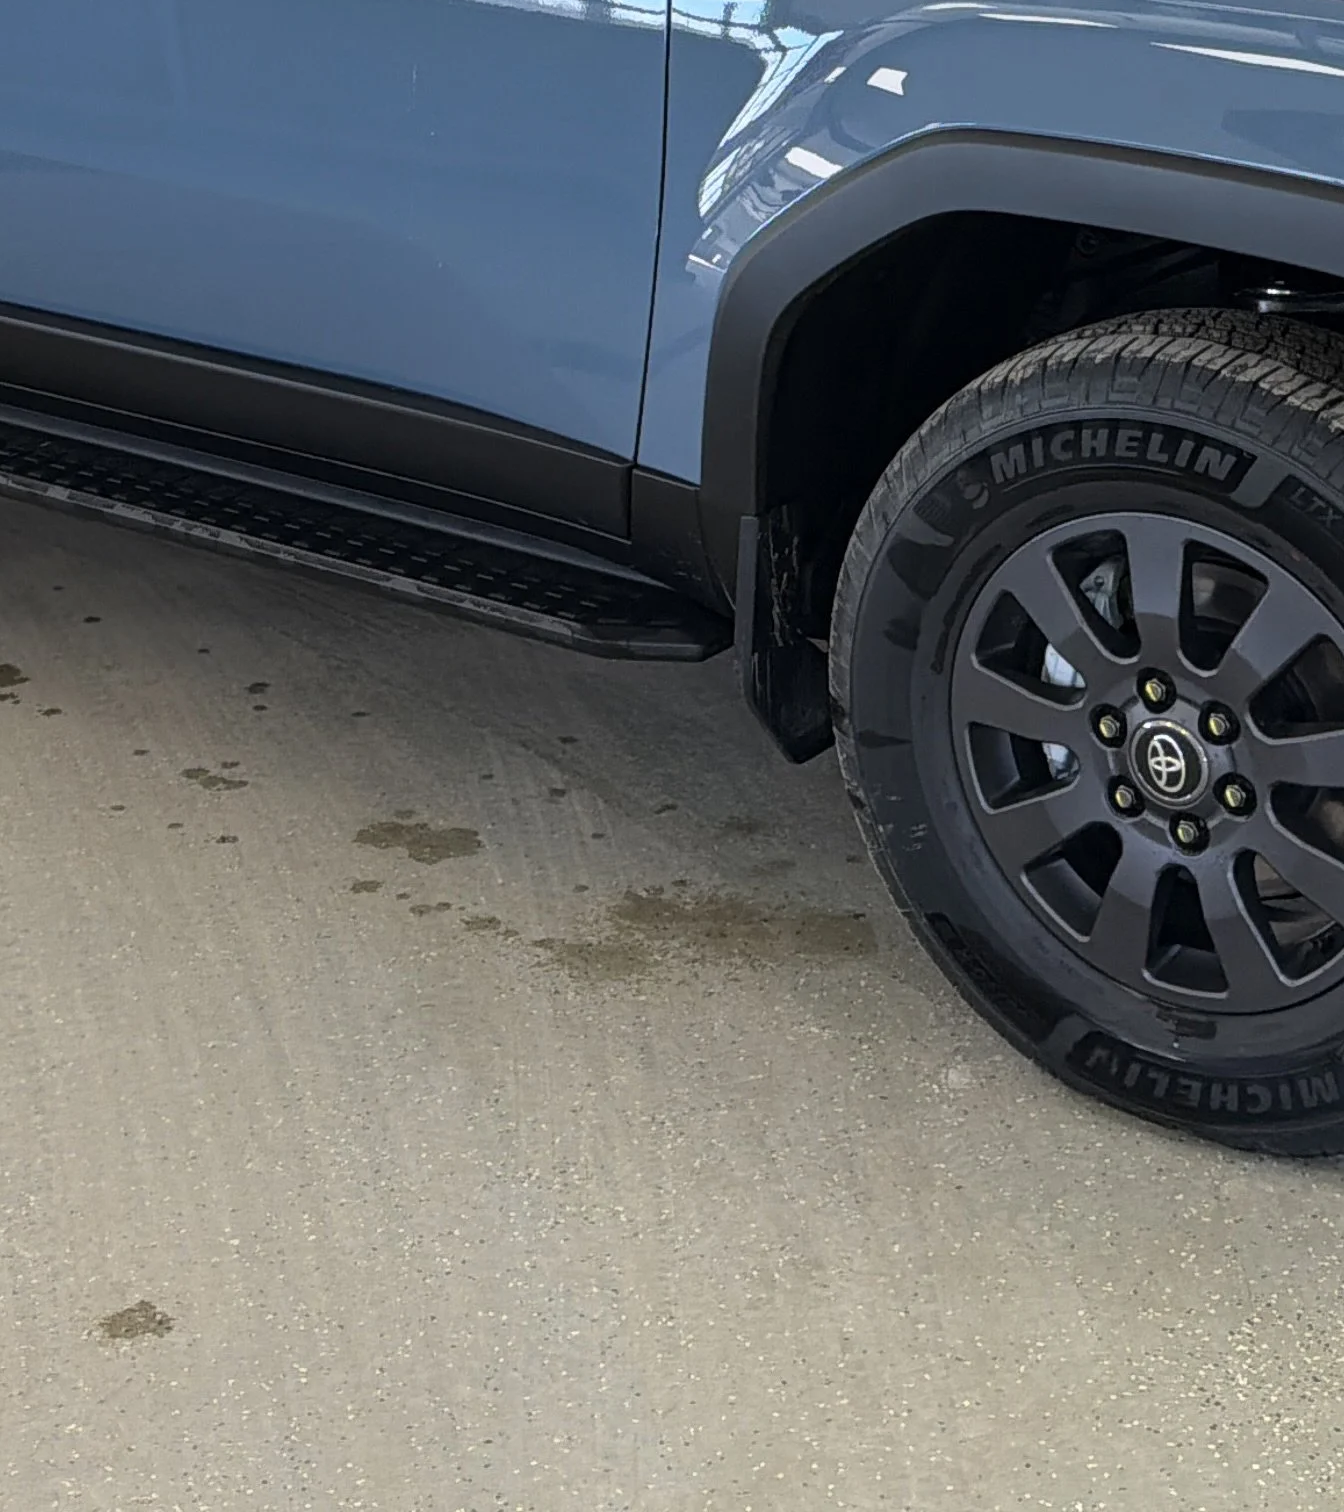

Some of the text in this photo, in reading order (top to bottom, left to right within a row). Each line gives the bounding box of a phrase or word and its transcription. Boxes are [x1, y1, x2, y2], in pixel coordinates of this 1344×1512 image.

[990, 427, 1238, 483] MICHELIN
[1289, 486, 1342, 528] LTX
[1086, 1045, 1340, 1114] MICHELIN
